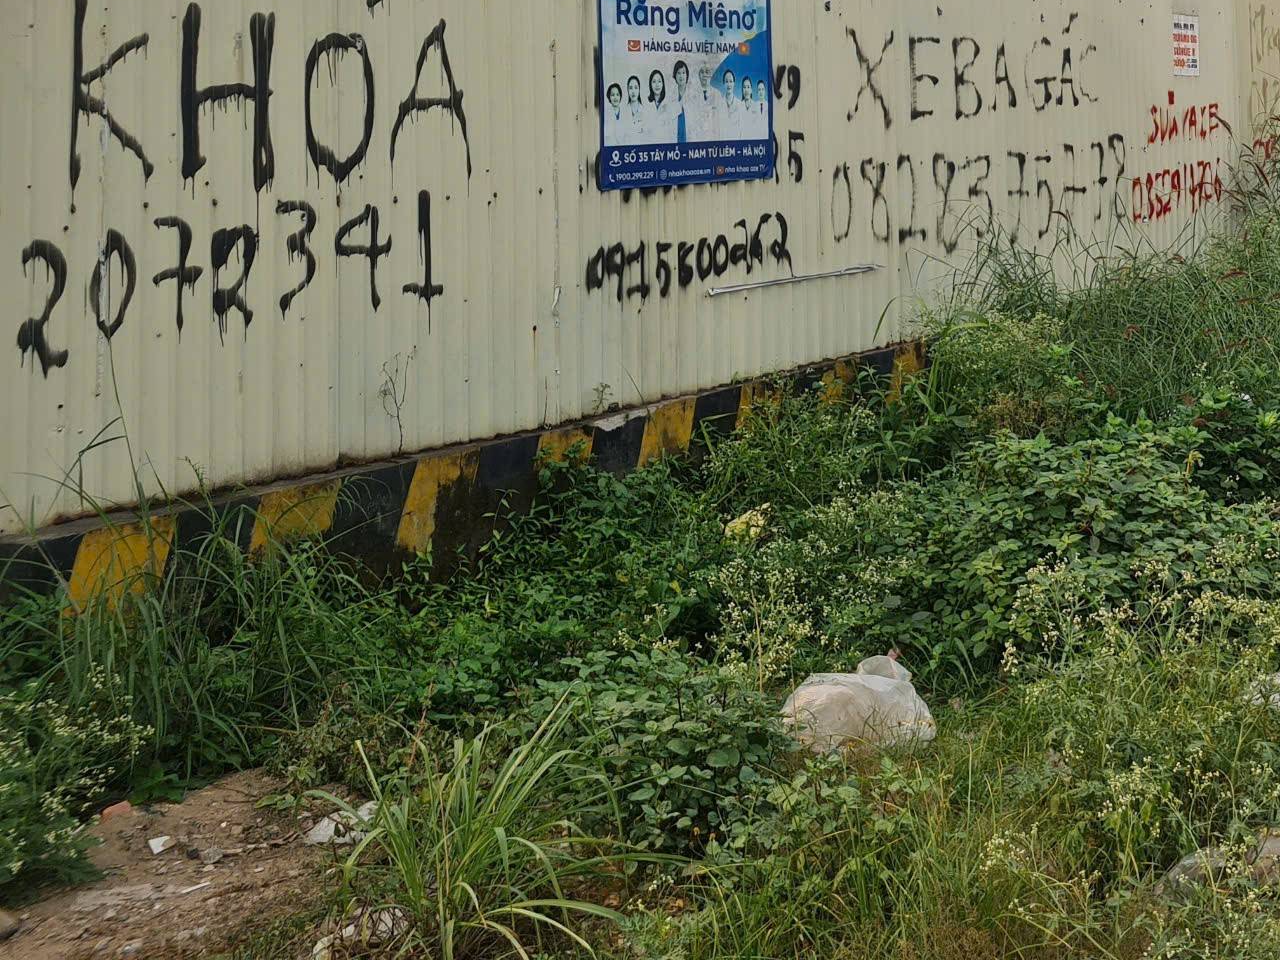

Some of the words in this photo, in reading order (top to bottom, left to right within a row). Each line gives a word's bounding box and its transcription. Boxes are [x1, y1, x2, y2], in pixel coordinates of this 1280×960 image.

[643, 38, 671, 52] HÀNG
[695, 38, 713, 55] VIỆT
[716, 42, 736, 53] NAM
[624, 149, 637, 163] SỐ
[638, 152, 648, 162] 35
[650, 150, 665, 161] TÂY
[688, 149, 706, 159] NAM
[719, 145, 735, 157] LIÊM
[742, 144, 753, 156] HÀ
[754, 144, 765, 159] NỘI
